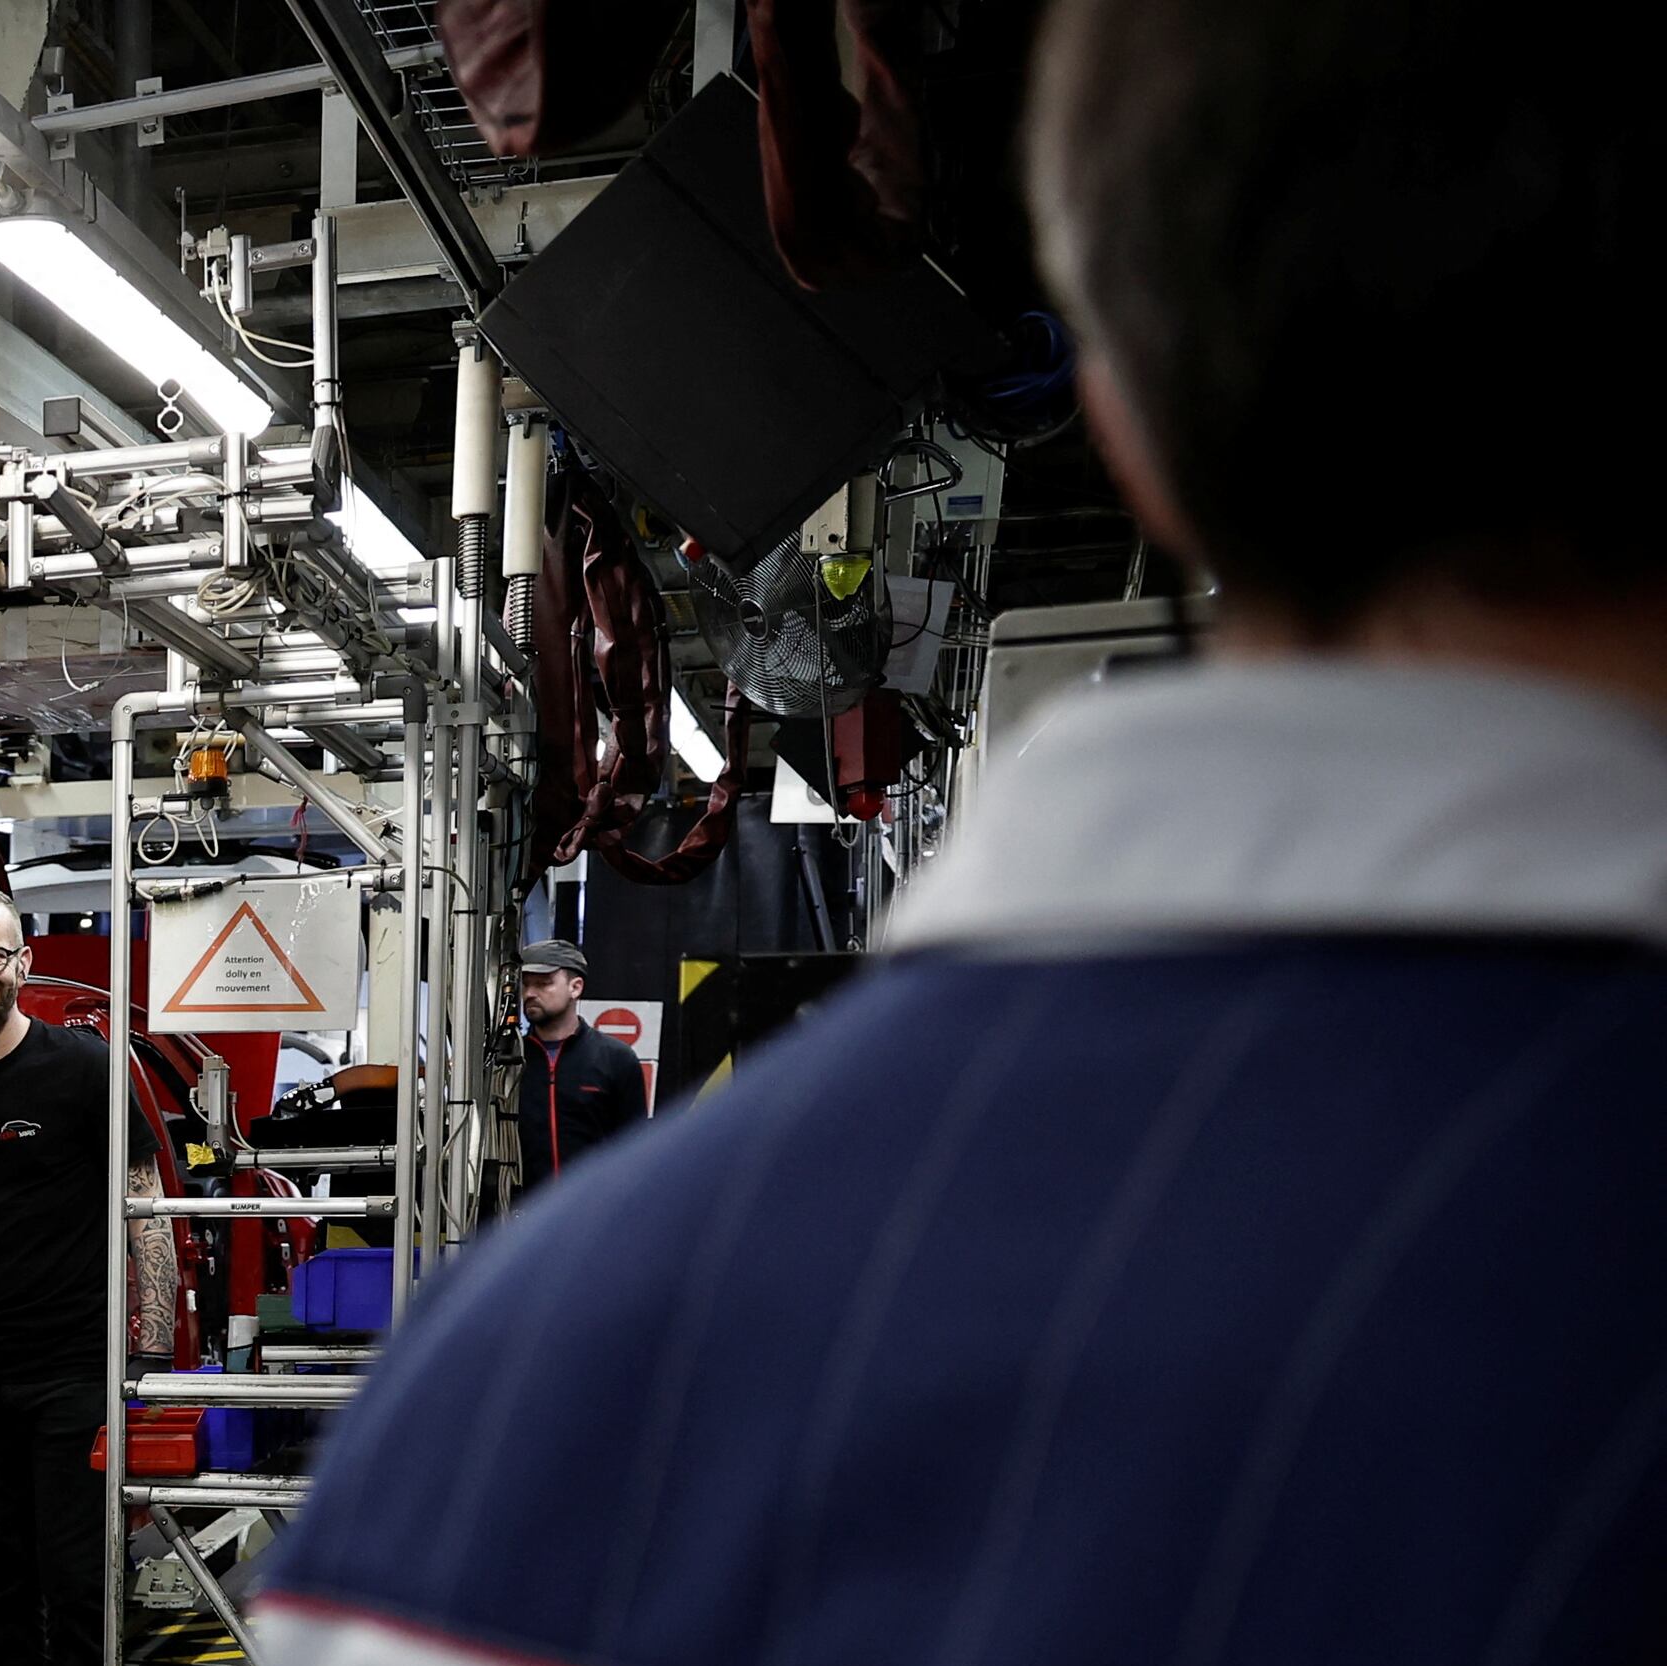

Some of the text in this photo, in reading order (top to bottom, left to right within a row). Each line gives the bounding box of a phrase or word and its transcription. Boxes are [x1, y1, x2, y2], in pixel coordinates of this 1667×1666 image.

[224, 955, 265, 965] Attention
[225, 969, 247, 980] dolly
[215, 983, 271, 993] mouvement
